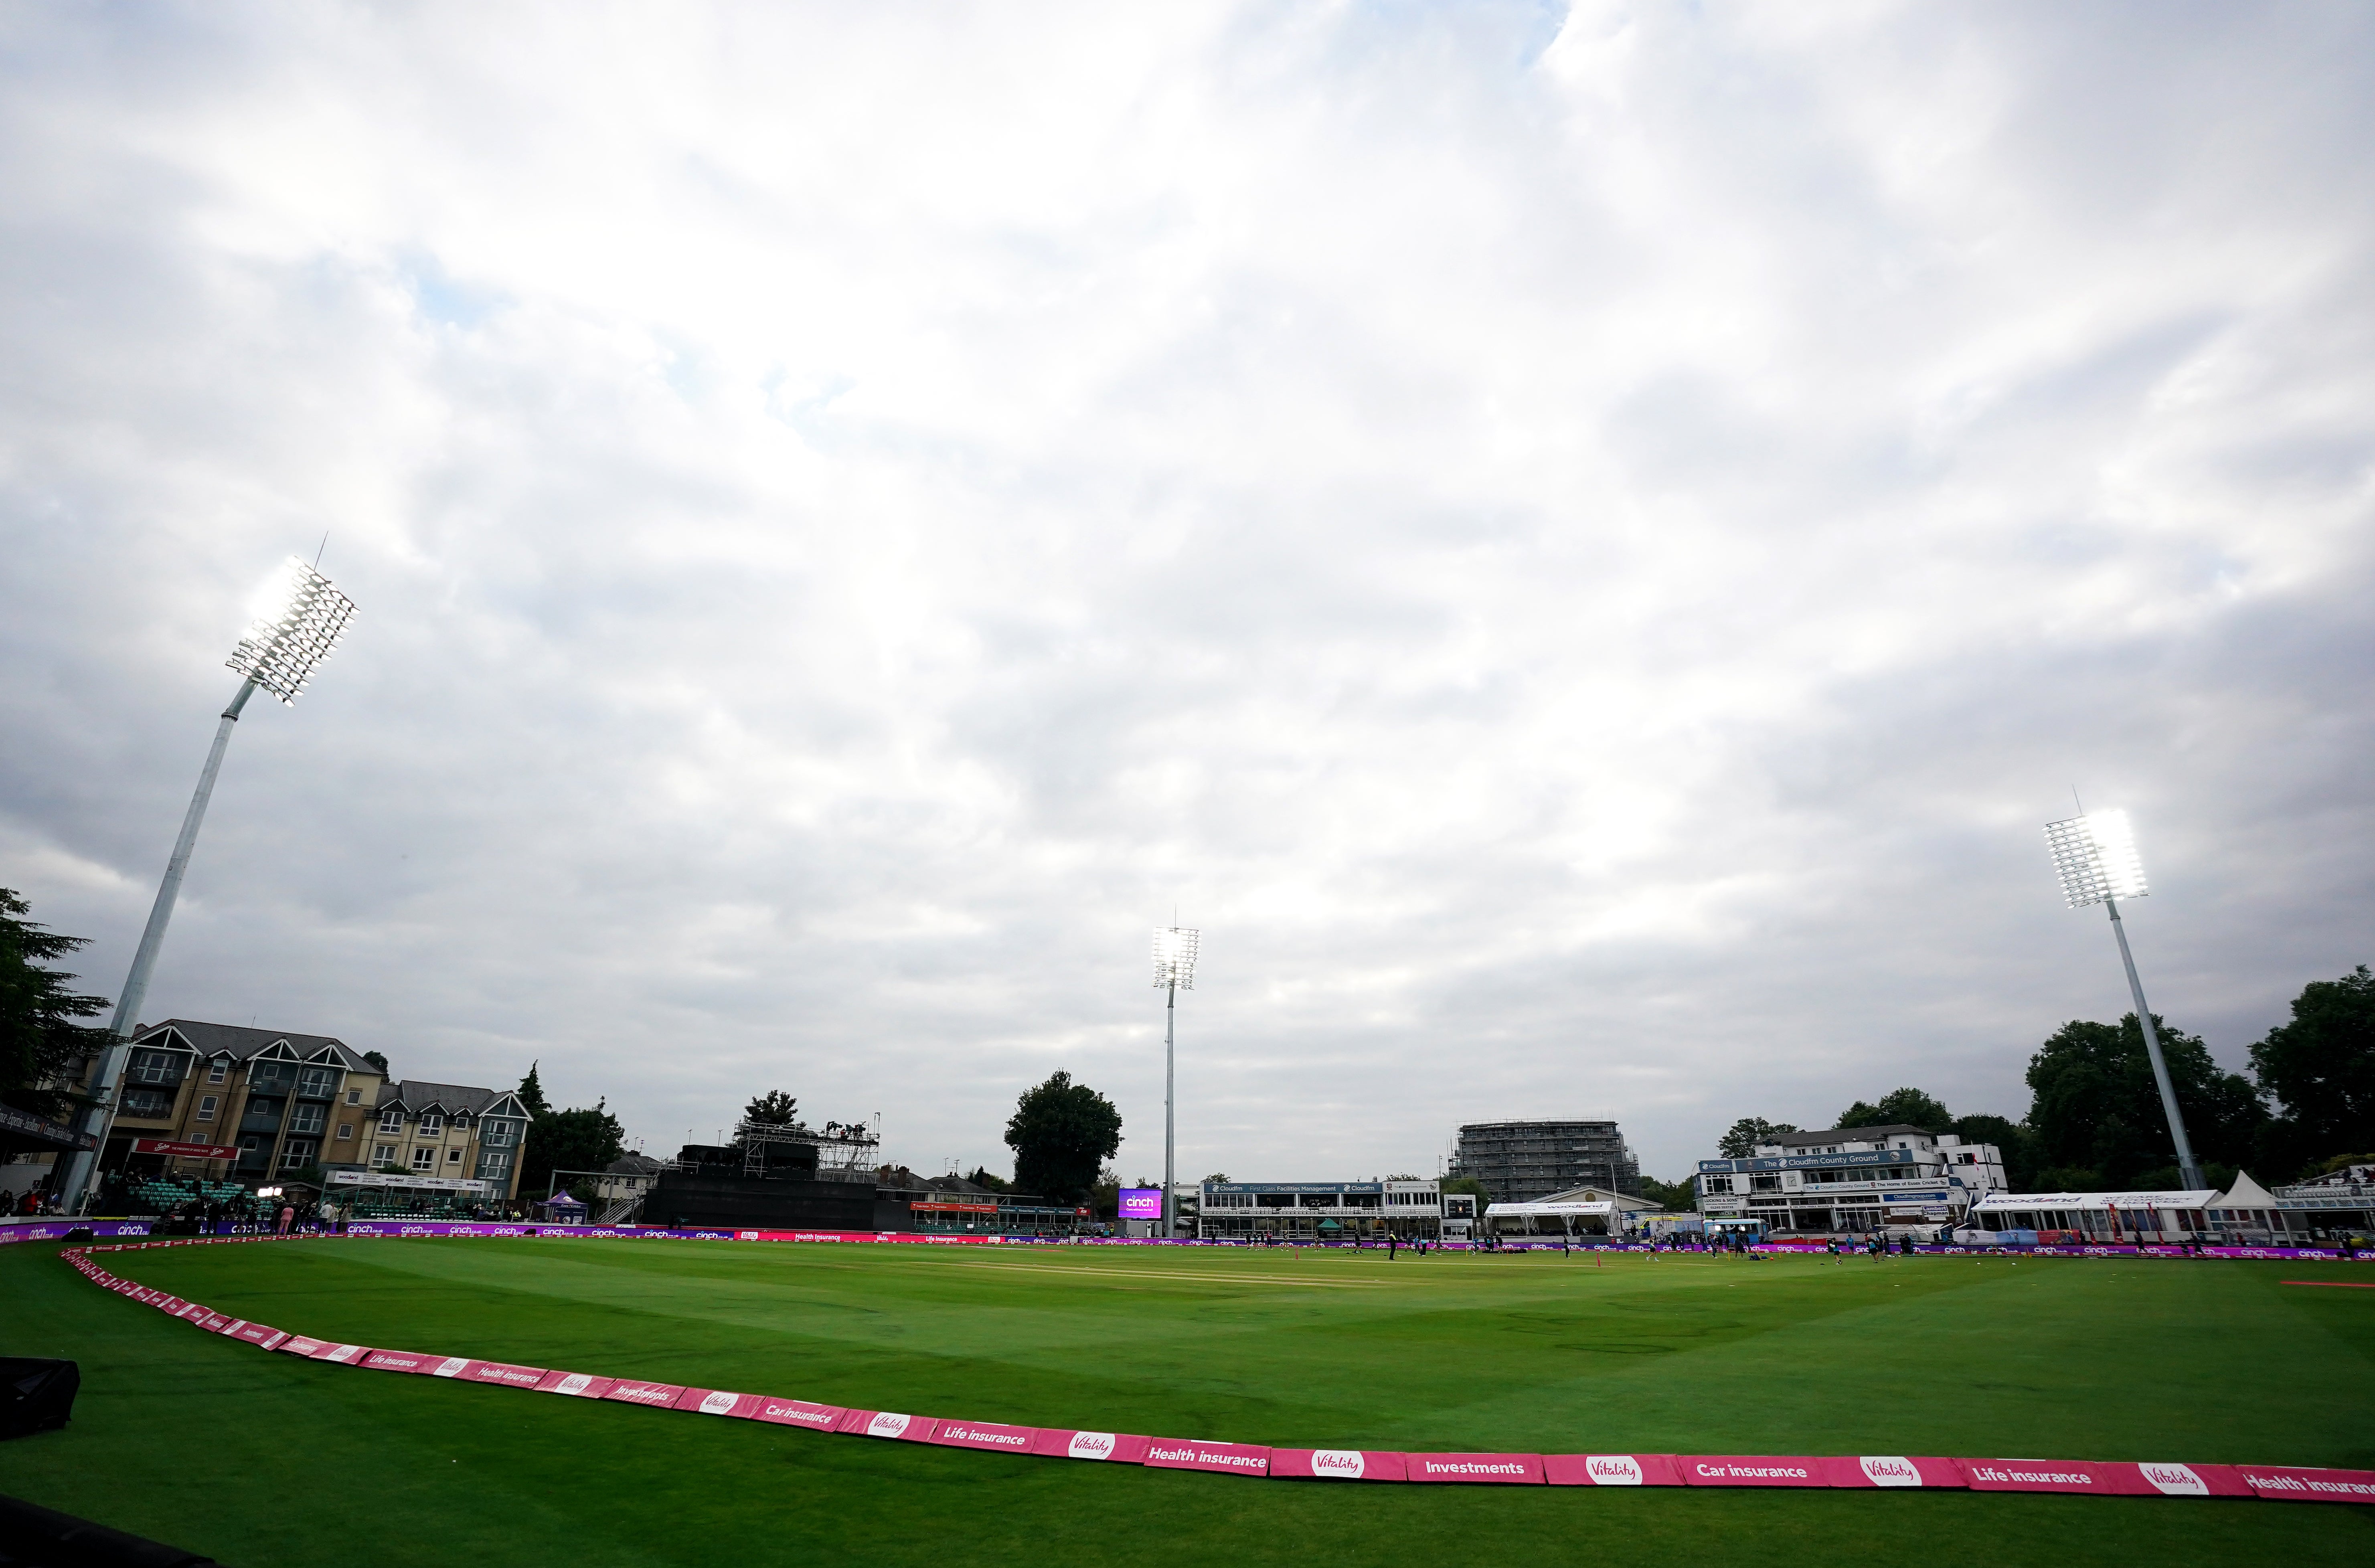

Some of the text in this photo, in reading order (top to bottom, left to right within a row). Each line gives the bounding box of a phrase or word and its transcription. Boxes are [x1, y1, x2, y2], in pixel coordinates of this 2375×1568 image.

[1820, 1156, 1847, 1164] County
[1126, 1195, 1153, 1207] cinch
[29, 1225, 53, 1239] cinch.co.uk
[348, 1223, 383, 1234] cinch.co.uk
[401, 1224, 433, 1234] cinch.co.uk
[450, 1224, 482, 1234] cinch.co.uk
[543, 1227, 574, 1235] cinch.co.uk
[369, 1355, 417, 1367] Life insurance
[440, 1360, 461, 1374] Vitality
[478, 1367, 540, 1383] Health insurance
[562, 1377, 584, 1390] Vitality
[617, 1385, 669, 1401] Investments
[706, 1395, 731, 1412] Vitality
[766, 1404, 832, 1423] Car insurance
[874, 1414, 903, 1433] Vitality
[944, 1427, 1025, 1445] Life insurance
[1074, 1436, 1109, 1455] Vitality
[1149, 1447, 1266, 1468] Health insurance
[1317, 1453, 1359, 1473] Vitality
[1425, 1461, 1525, 1475] Investments
[1590, 1461, 1636, 1480] Vitality
[1696, 1464, 1807, 1478] Car insurance
[1865, 1460, 1914, 1481] Vitality
[1972, 1468, 2092, 1484] Life insurance
[2148, 1467, 2199, 1489] Vitality
[2243, 1474, 2306, 1490] Health
